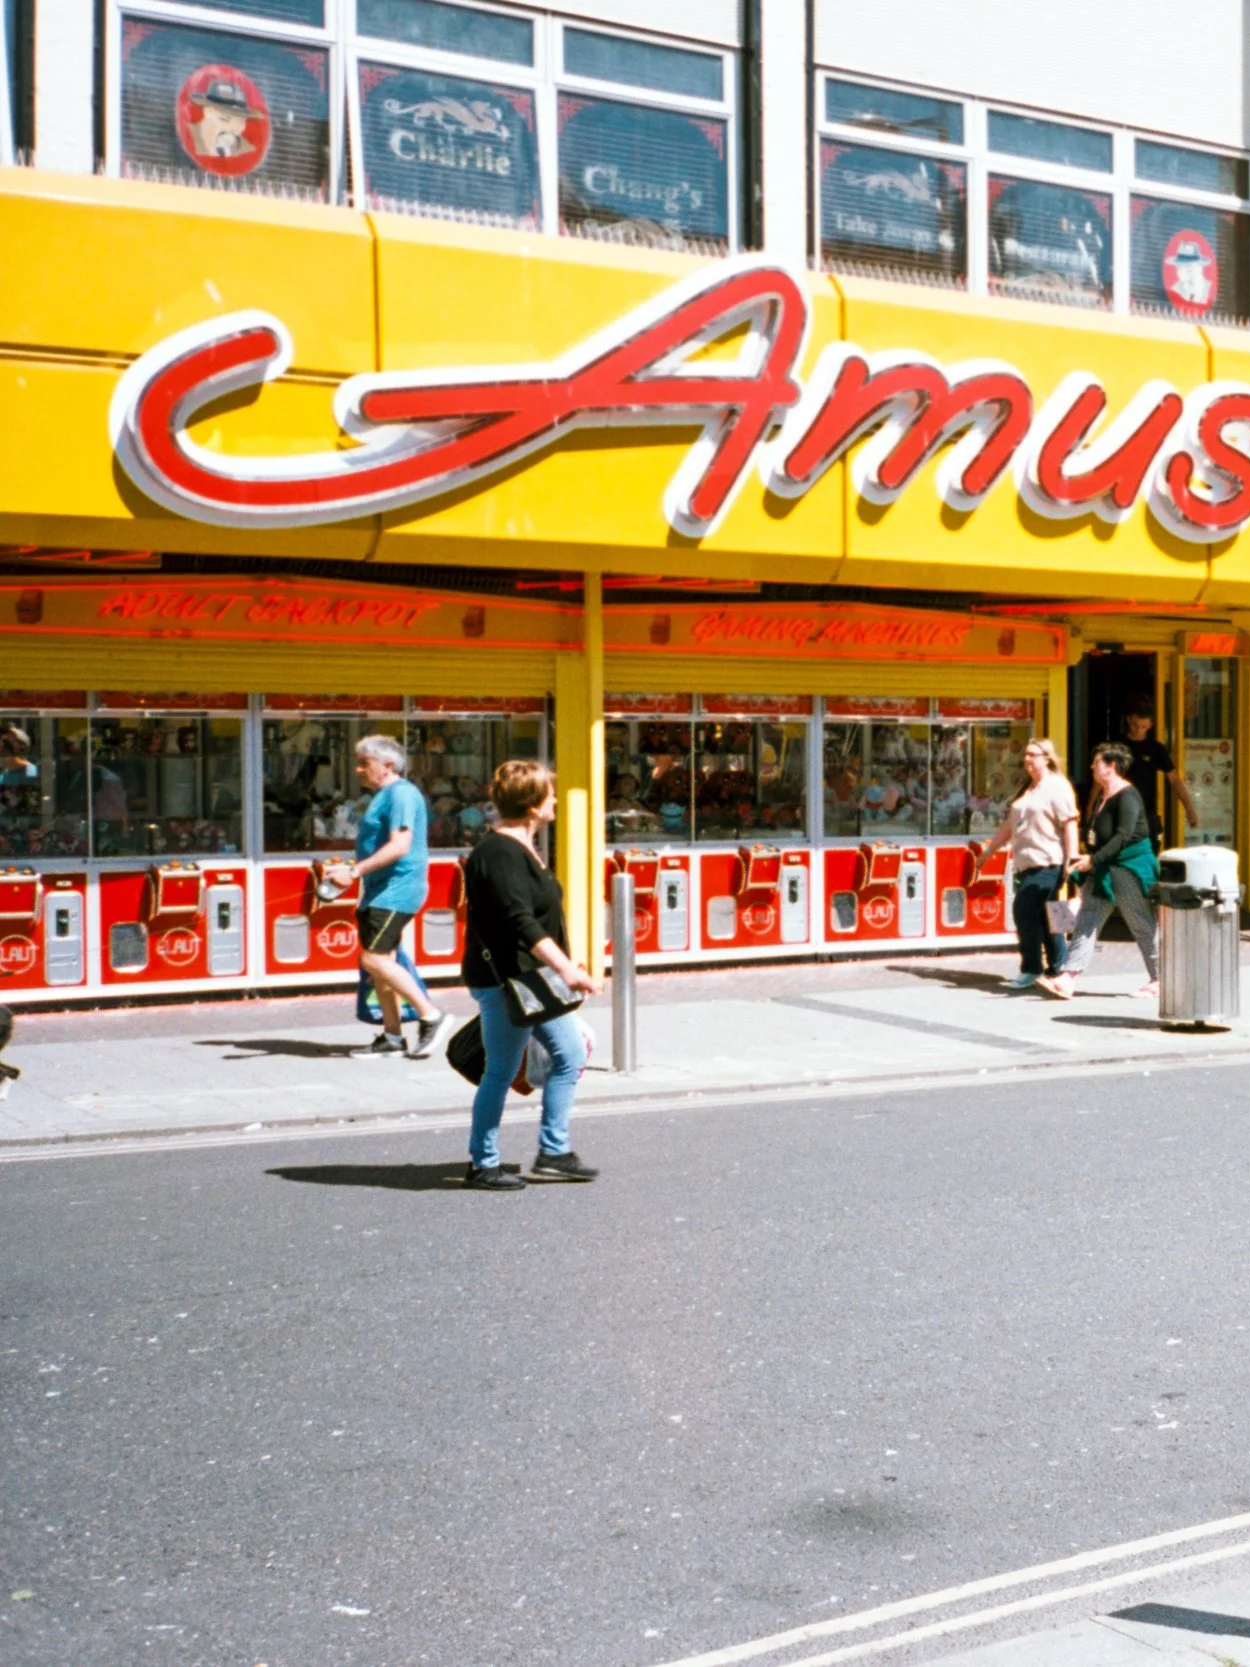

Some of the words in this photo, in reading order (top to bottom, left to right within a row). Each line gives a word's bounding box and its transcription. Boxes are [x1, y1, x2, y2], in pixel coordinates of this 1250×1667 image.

[388, 130, 512, 176] Charlie
[583, 165, 703, 215] Chang's
[99, 590, 251, 622] ADULT
[245, 595, 441, 630] JACKPOT
[691, 610, 821, 648] GAMING
[810, 618, 971, 648] MACHINES
